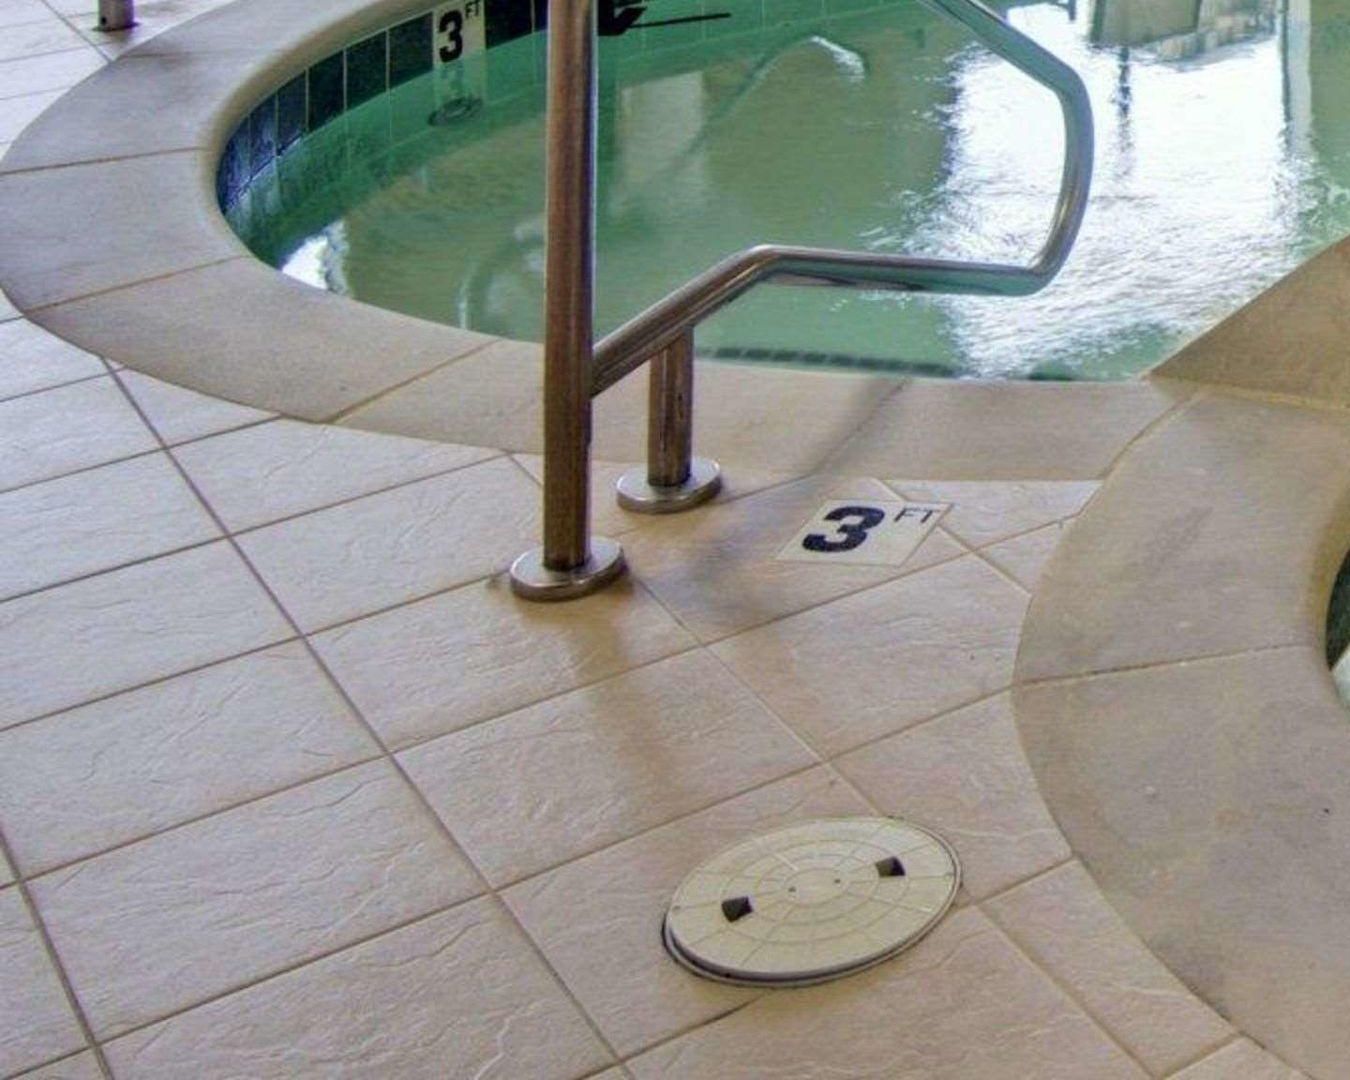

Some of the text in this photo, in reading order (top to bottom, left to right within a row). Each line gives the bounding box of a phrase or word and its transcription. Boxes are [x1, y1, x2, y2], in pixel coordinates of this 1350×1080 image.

[439, 9, 463, 63] 3
[802, 506, 941, 553] 3 FT
